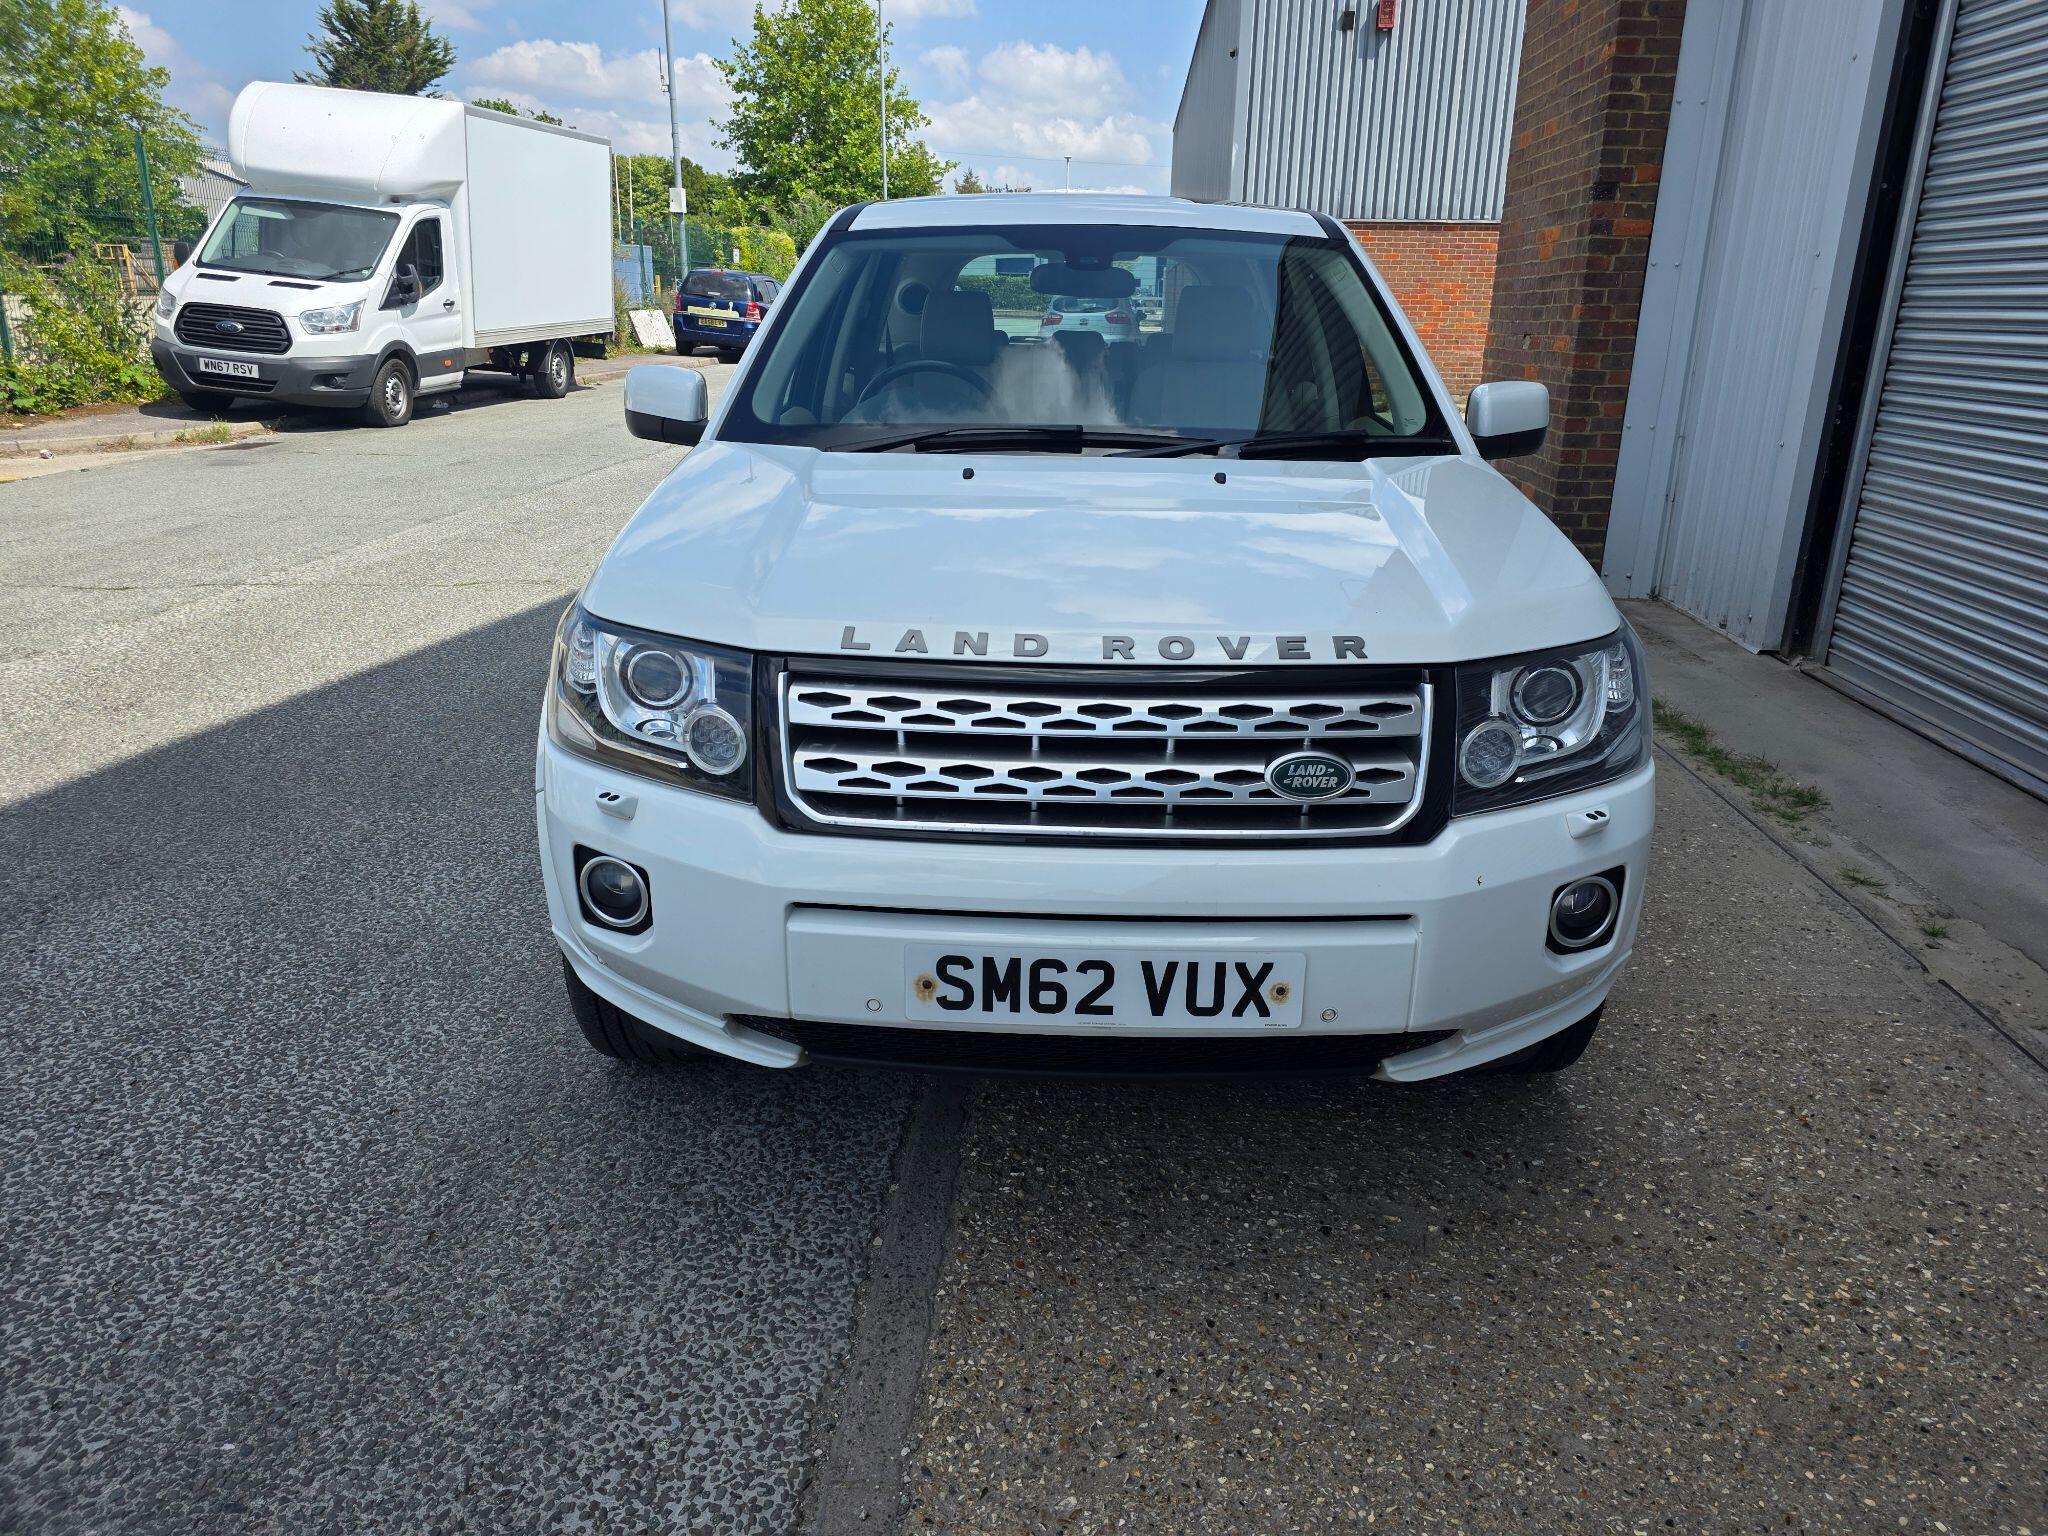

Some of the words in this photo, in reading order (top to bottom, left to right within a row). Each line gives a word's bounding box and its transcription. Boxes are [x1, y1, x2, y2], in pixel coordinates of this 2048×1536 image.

[203, 360, 230, 373] WN67
[233, 363, 253, 375] RSV
[840, 626, 1048, 657] LAND
[1102, 634, 1368, 660] ROVER
[1287, 764, 1326, 776] LAND
[1291, 776, 1338, 788] ROVER
[935, 955, 1115, 1016] SM62
[1140, 960, 1274, 1018] VUX
